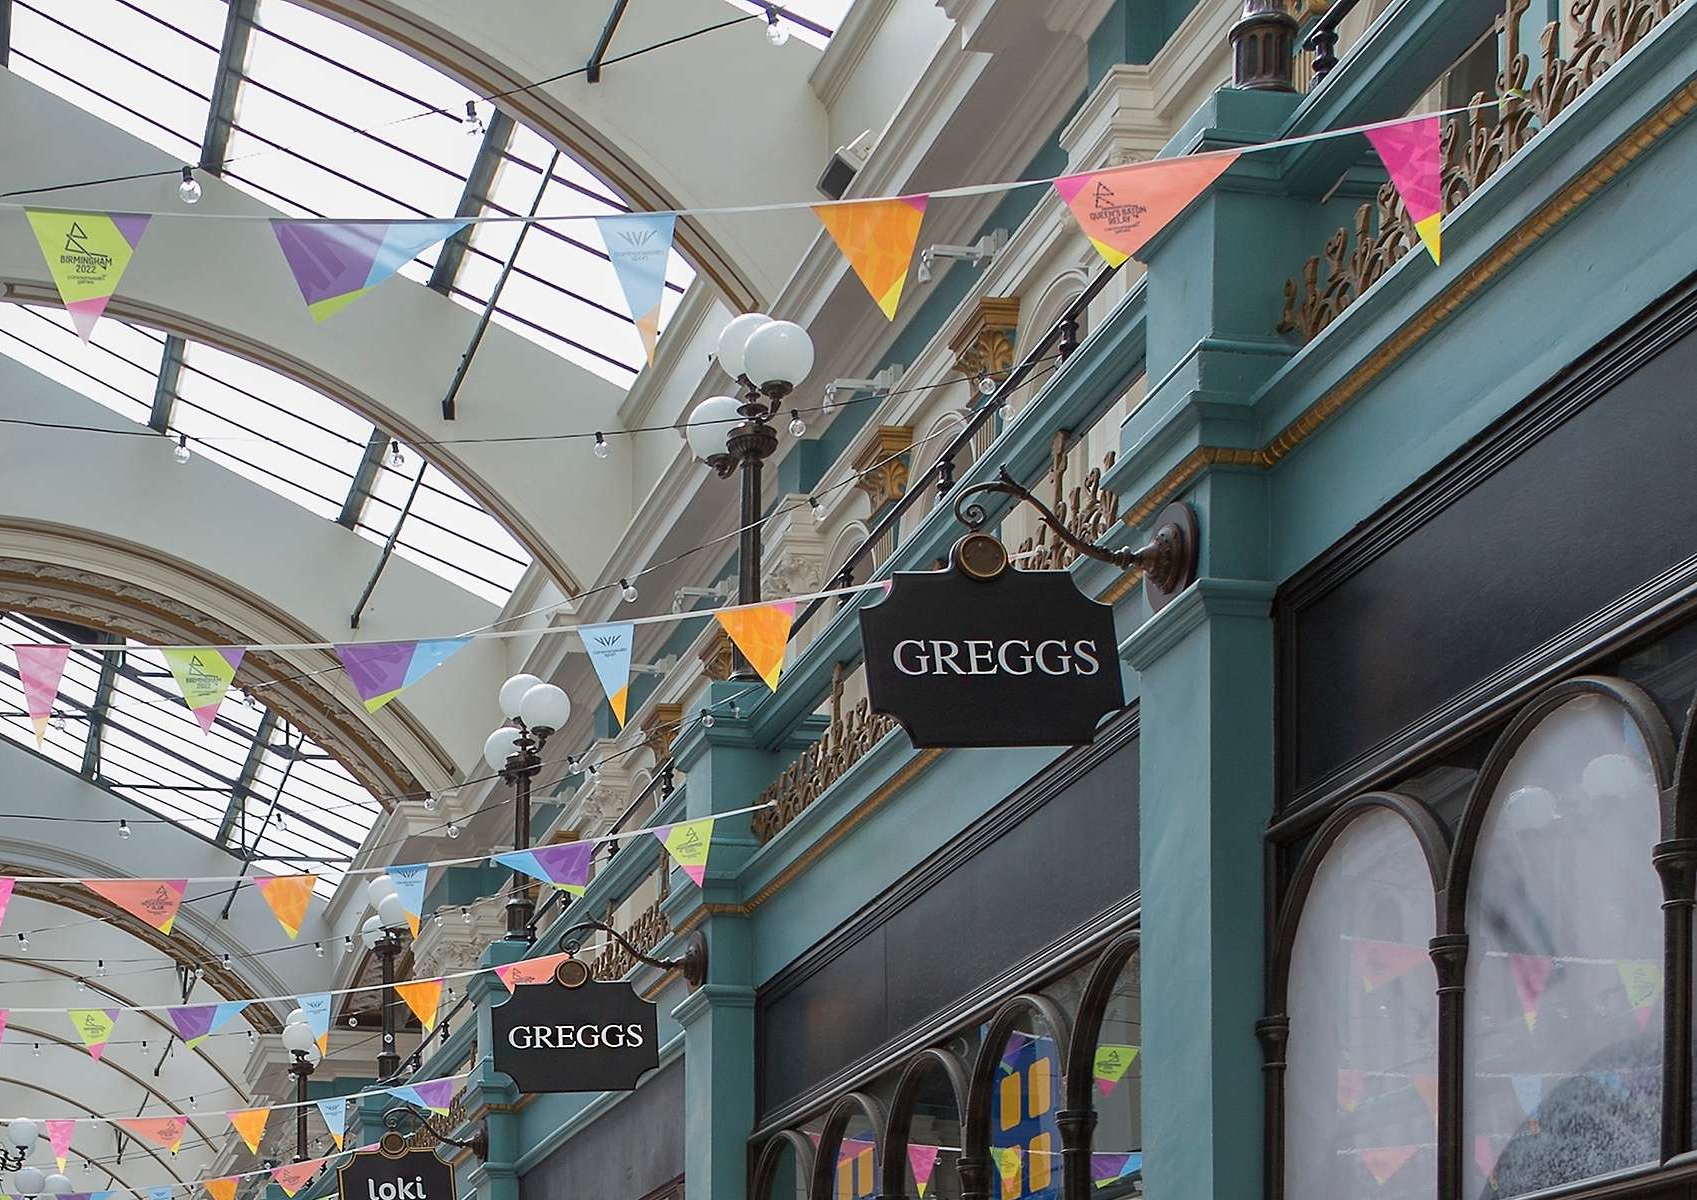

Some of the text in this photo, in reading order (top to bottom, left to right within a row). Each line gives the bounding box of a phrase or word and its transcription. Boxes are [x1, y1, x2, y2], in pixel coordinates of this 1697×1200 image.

[60, 255, 113, 266] BIRMINGHAM
[76, 265, 96, 273] 2022
[893, 639, 1100, 676] GREGGS
[508, 1024, 643, 1049] GREGGS
